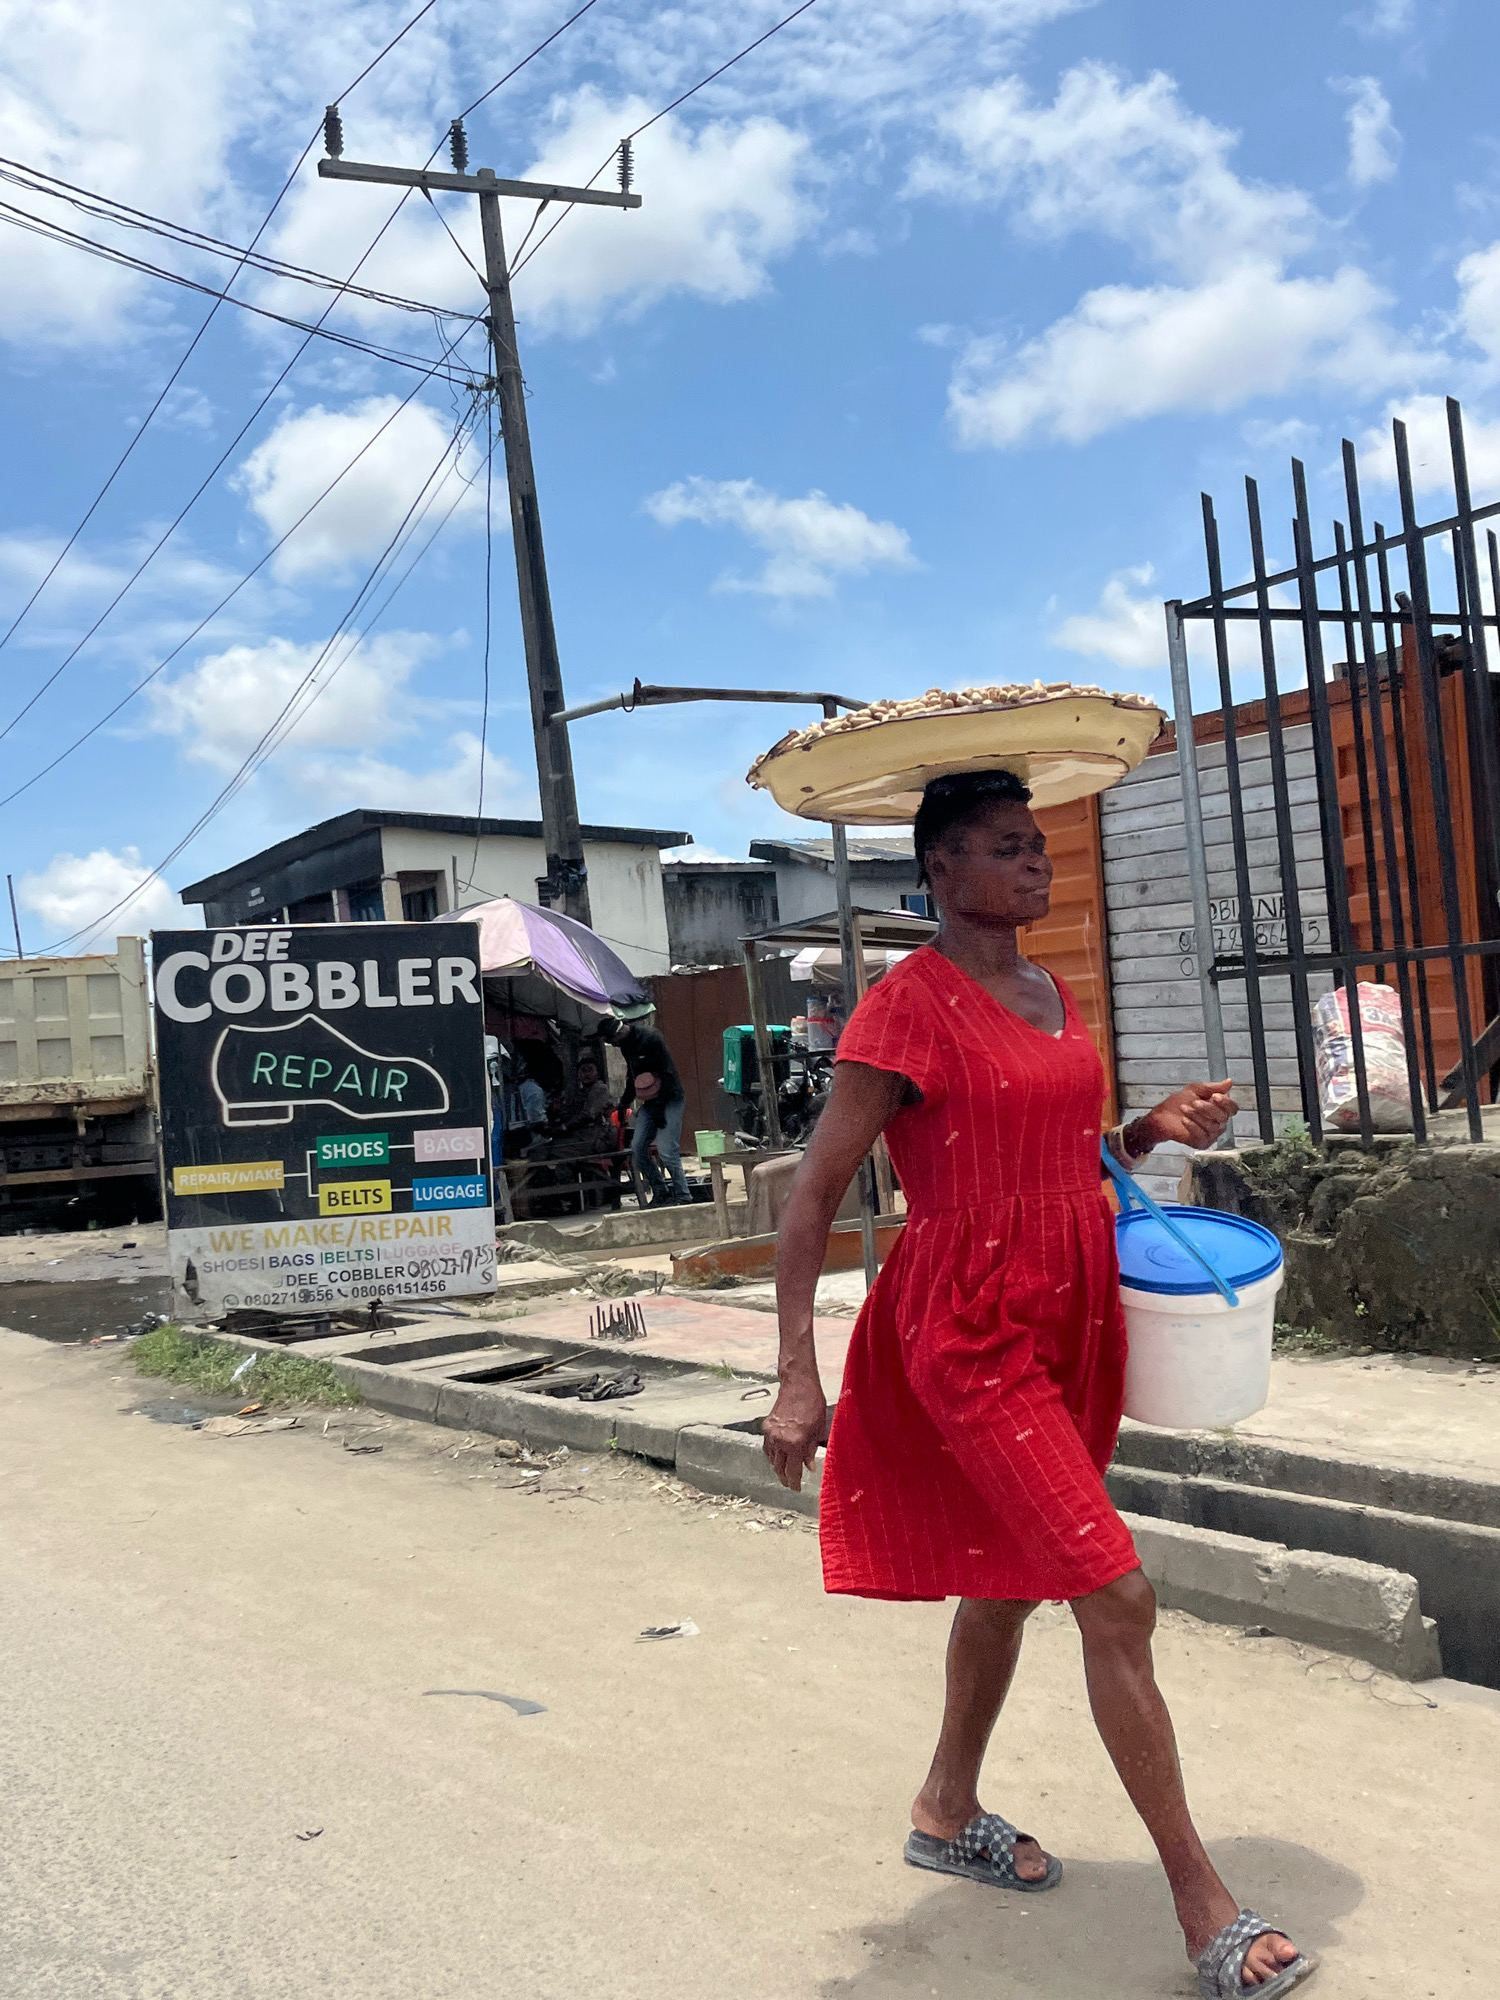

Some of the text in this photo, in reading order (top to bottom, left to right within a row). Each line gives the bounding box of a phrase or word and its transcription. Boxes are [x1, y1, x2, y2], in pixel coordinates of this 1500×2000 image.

[211, 931, 293, 963] DEE
[155, 951, 481, 1023] COBBLER
[252, 1051, 409, 1101] REPAIR
[321, 1141, 385, 1161] SHOES
[423, 1136, 477, 1154] BAGS
[179, 1168, 282, 1187] REPAIR/MAKE
[328, 1187, 383, 1207] BELTS
[415, 1183, 484, 1202] LUGGAGE
[208, 1215, 453, 1253] WE MAKE/REPAIR
[269, 1253, 315, 1269] BAGS
[286, 1266, 405, 1288] DEE_COBBLER
[351, 1279, 447, 1299] 08066151456
